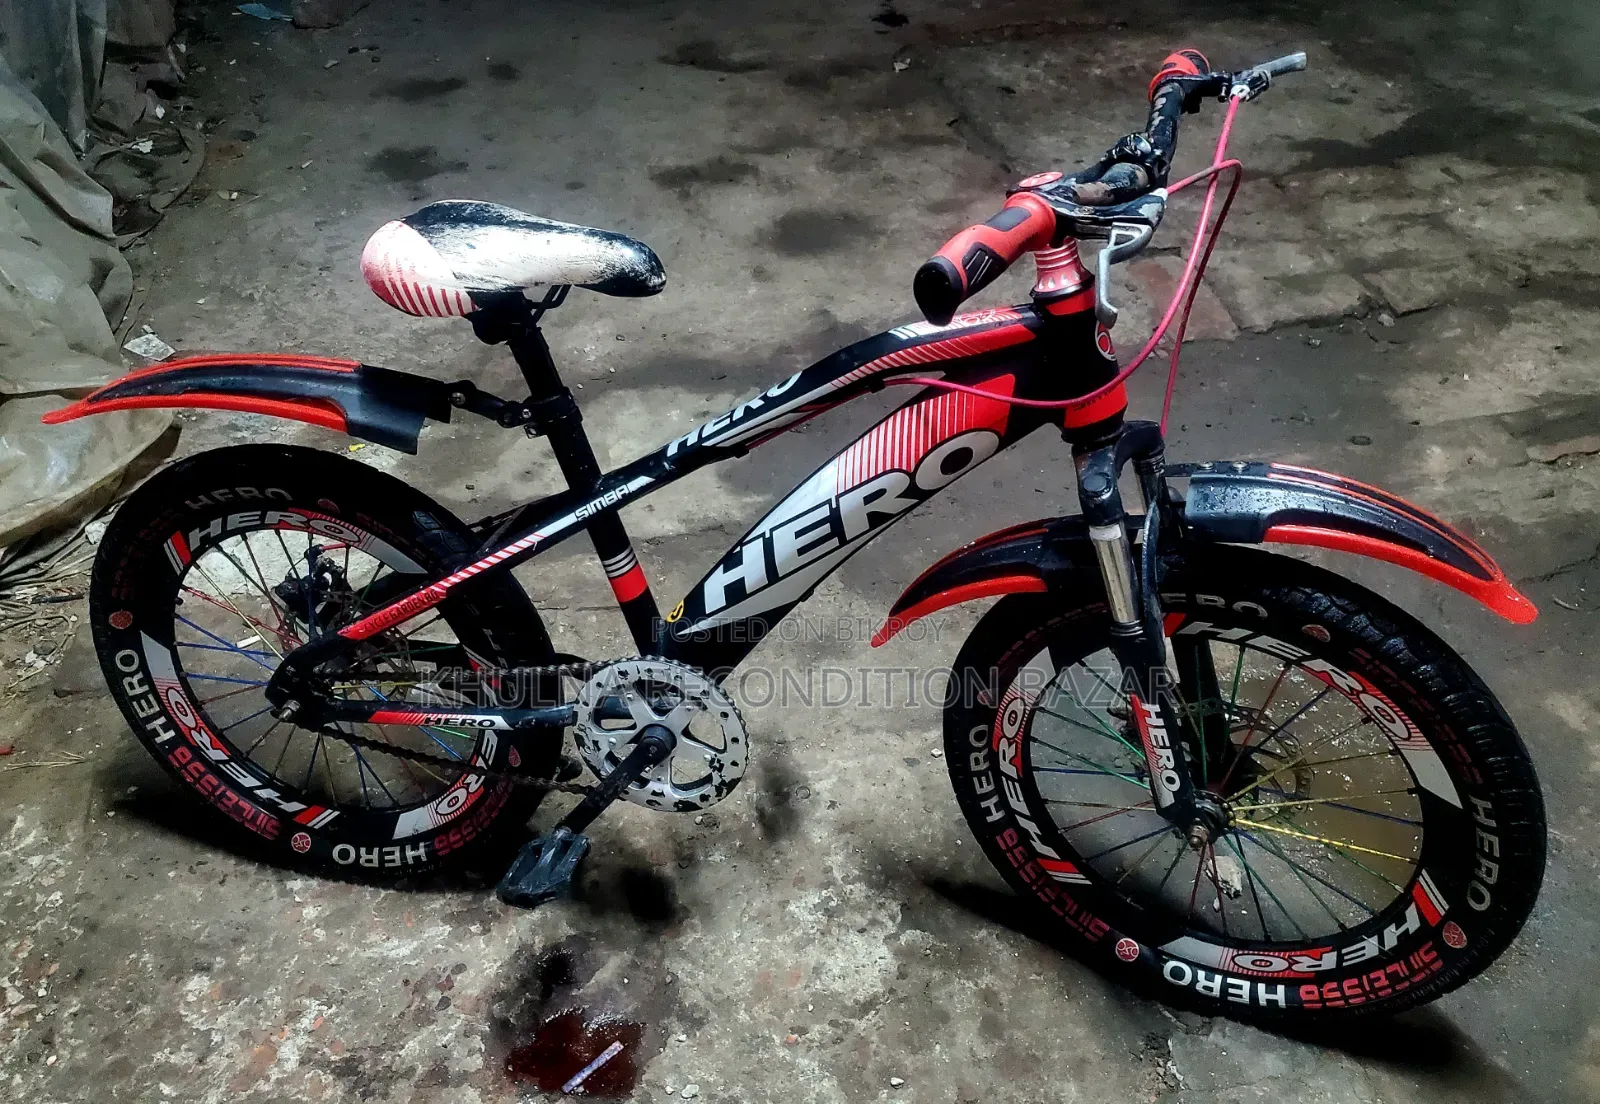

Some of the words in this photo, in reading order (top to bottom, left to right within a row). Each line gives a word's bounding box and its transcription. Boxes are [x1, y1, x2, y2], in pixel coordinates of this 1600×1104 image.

[188, 510, 361, 551] HERO
[575, 484, 630, 521] SIMBA
[703, 429, 1000, 615] HERO
[1159, 592, 1268, 619] ERO
[115, 649, 176, 744] HERO
[423, 716, 496, 728] HERO
[1179, 621, 1412, 741] HERO
[165, 687, 308, 813] HERO
[969, 724, 1006, 823] HERO
[998, 697, 1061, 860] HERO
[1141, 703, 1181, 792] HERO
[332, 841, 427, 868] HERO
[1466, 794, 1500, 911] HERO
[1232, 901, 1422, 973] HERO
[1163, 959, 1287, 1009] HERO
